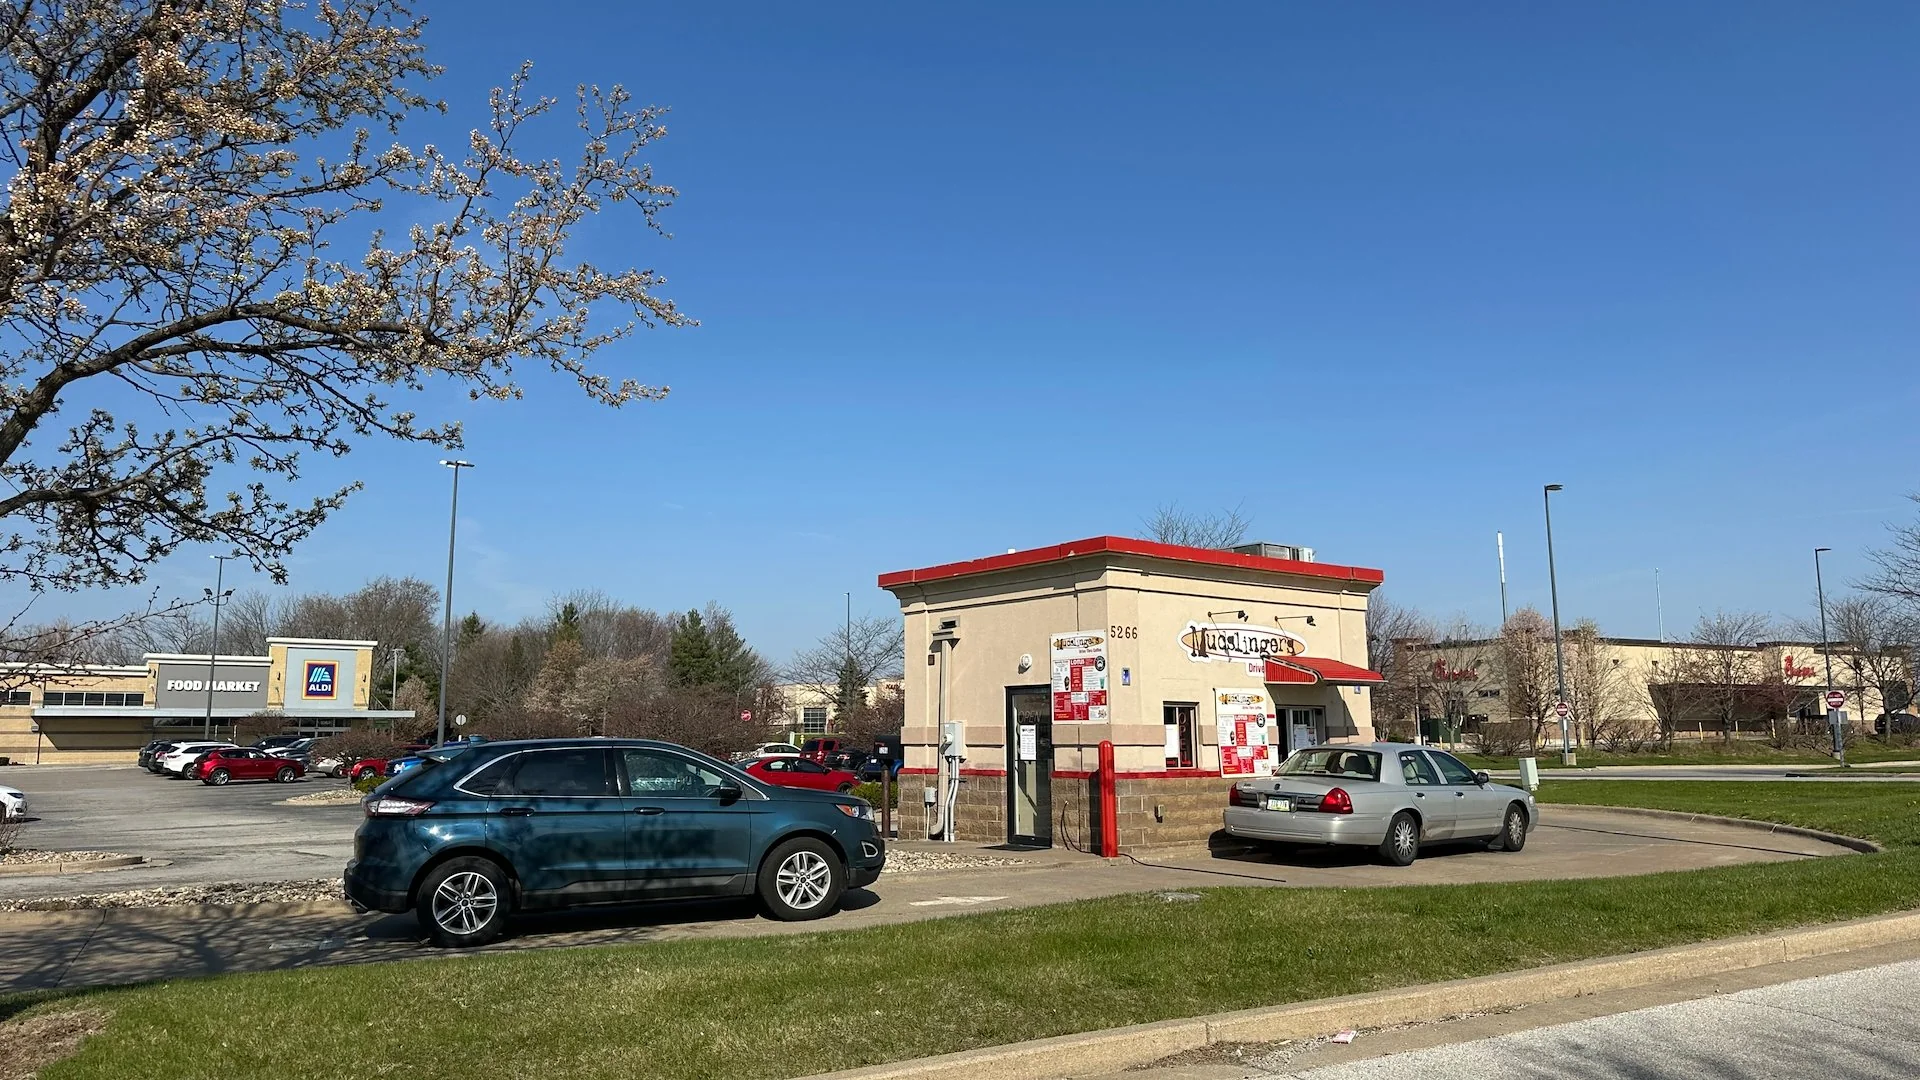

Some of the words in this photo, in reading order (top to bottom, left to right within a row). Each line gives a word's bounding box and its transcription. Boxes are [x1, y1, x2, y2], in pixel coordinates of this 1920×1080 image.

[1110, 625, 1138, 640] 5266
[1190, 625, 1296, 659] Mudslingers
[1248, 663, 1265, 674] Drive
[167, 680, 203, 691] FOOD
[204, 680, 260, 692] MARKET
[308, 684, 332, 692] ALDI
[1019, 710, 1042, 723] OPEN
